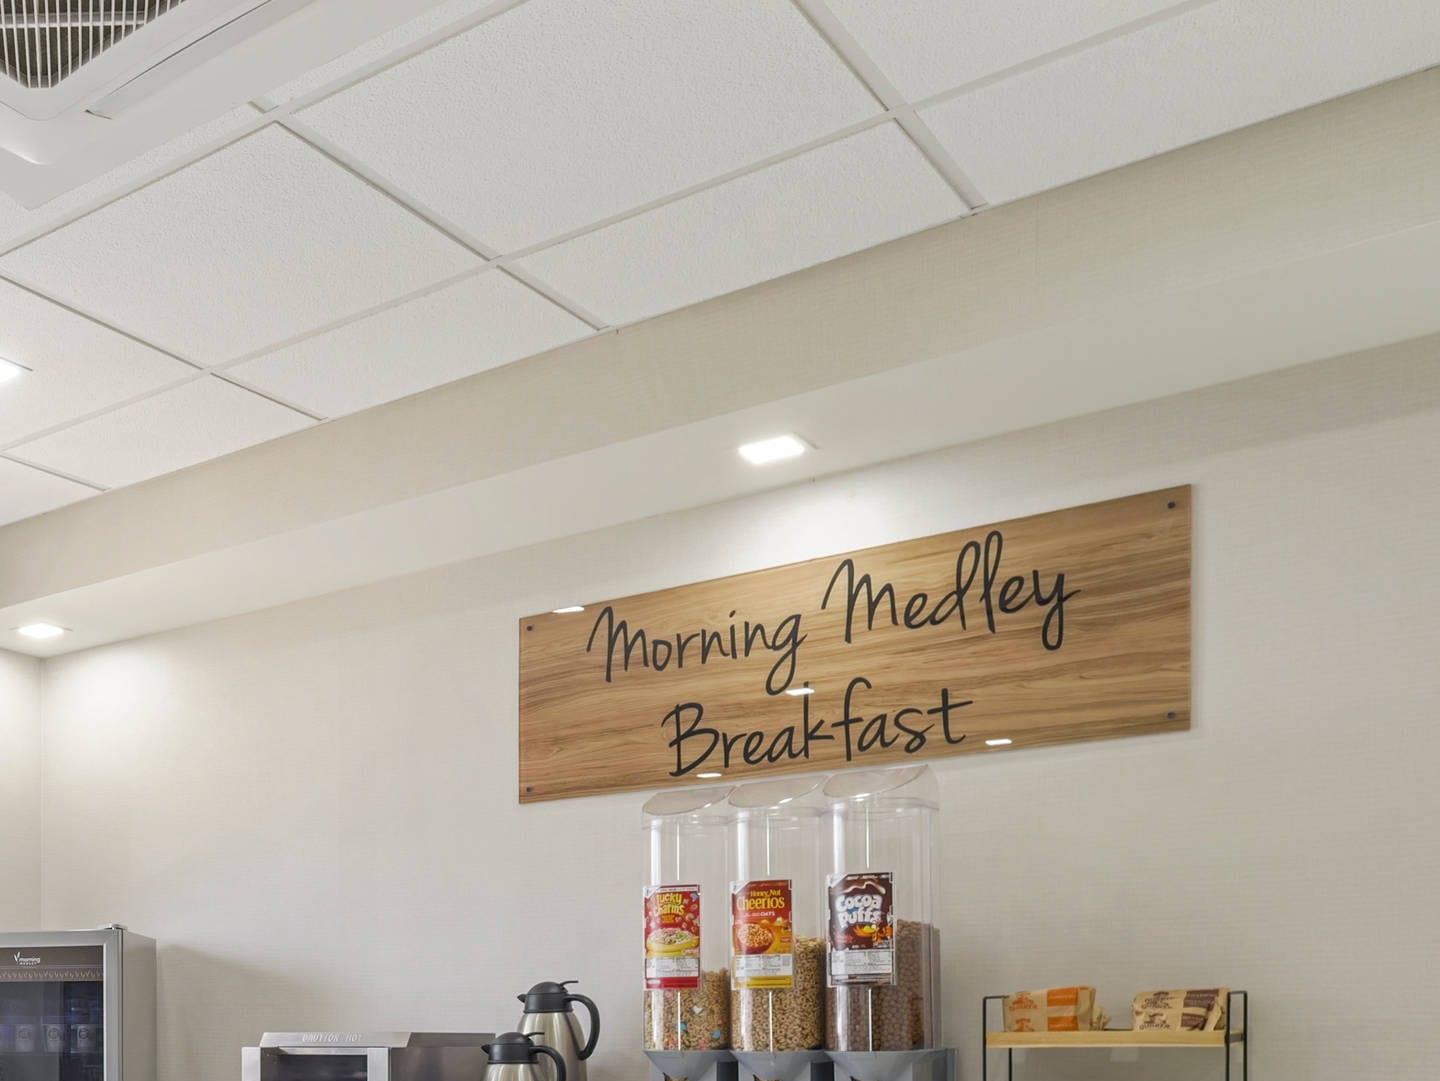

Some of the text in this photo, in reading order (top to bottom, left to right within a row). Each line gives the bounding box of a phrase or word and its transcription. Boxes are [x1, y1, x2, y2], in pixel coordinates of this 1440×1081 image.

[587, 530, 1081, 696] Morning Medley
[661, 677, 973, 777] Breakfast
[736, 895, 785, 911] Cheerios
[835, 894, 883, 912] Cocoa
